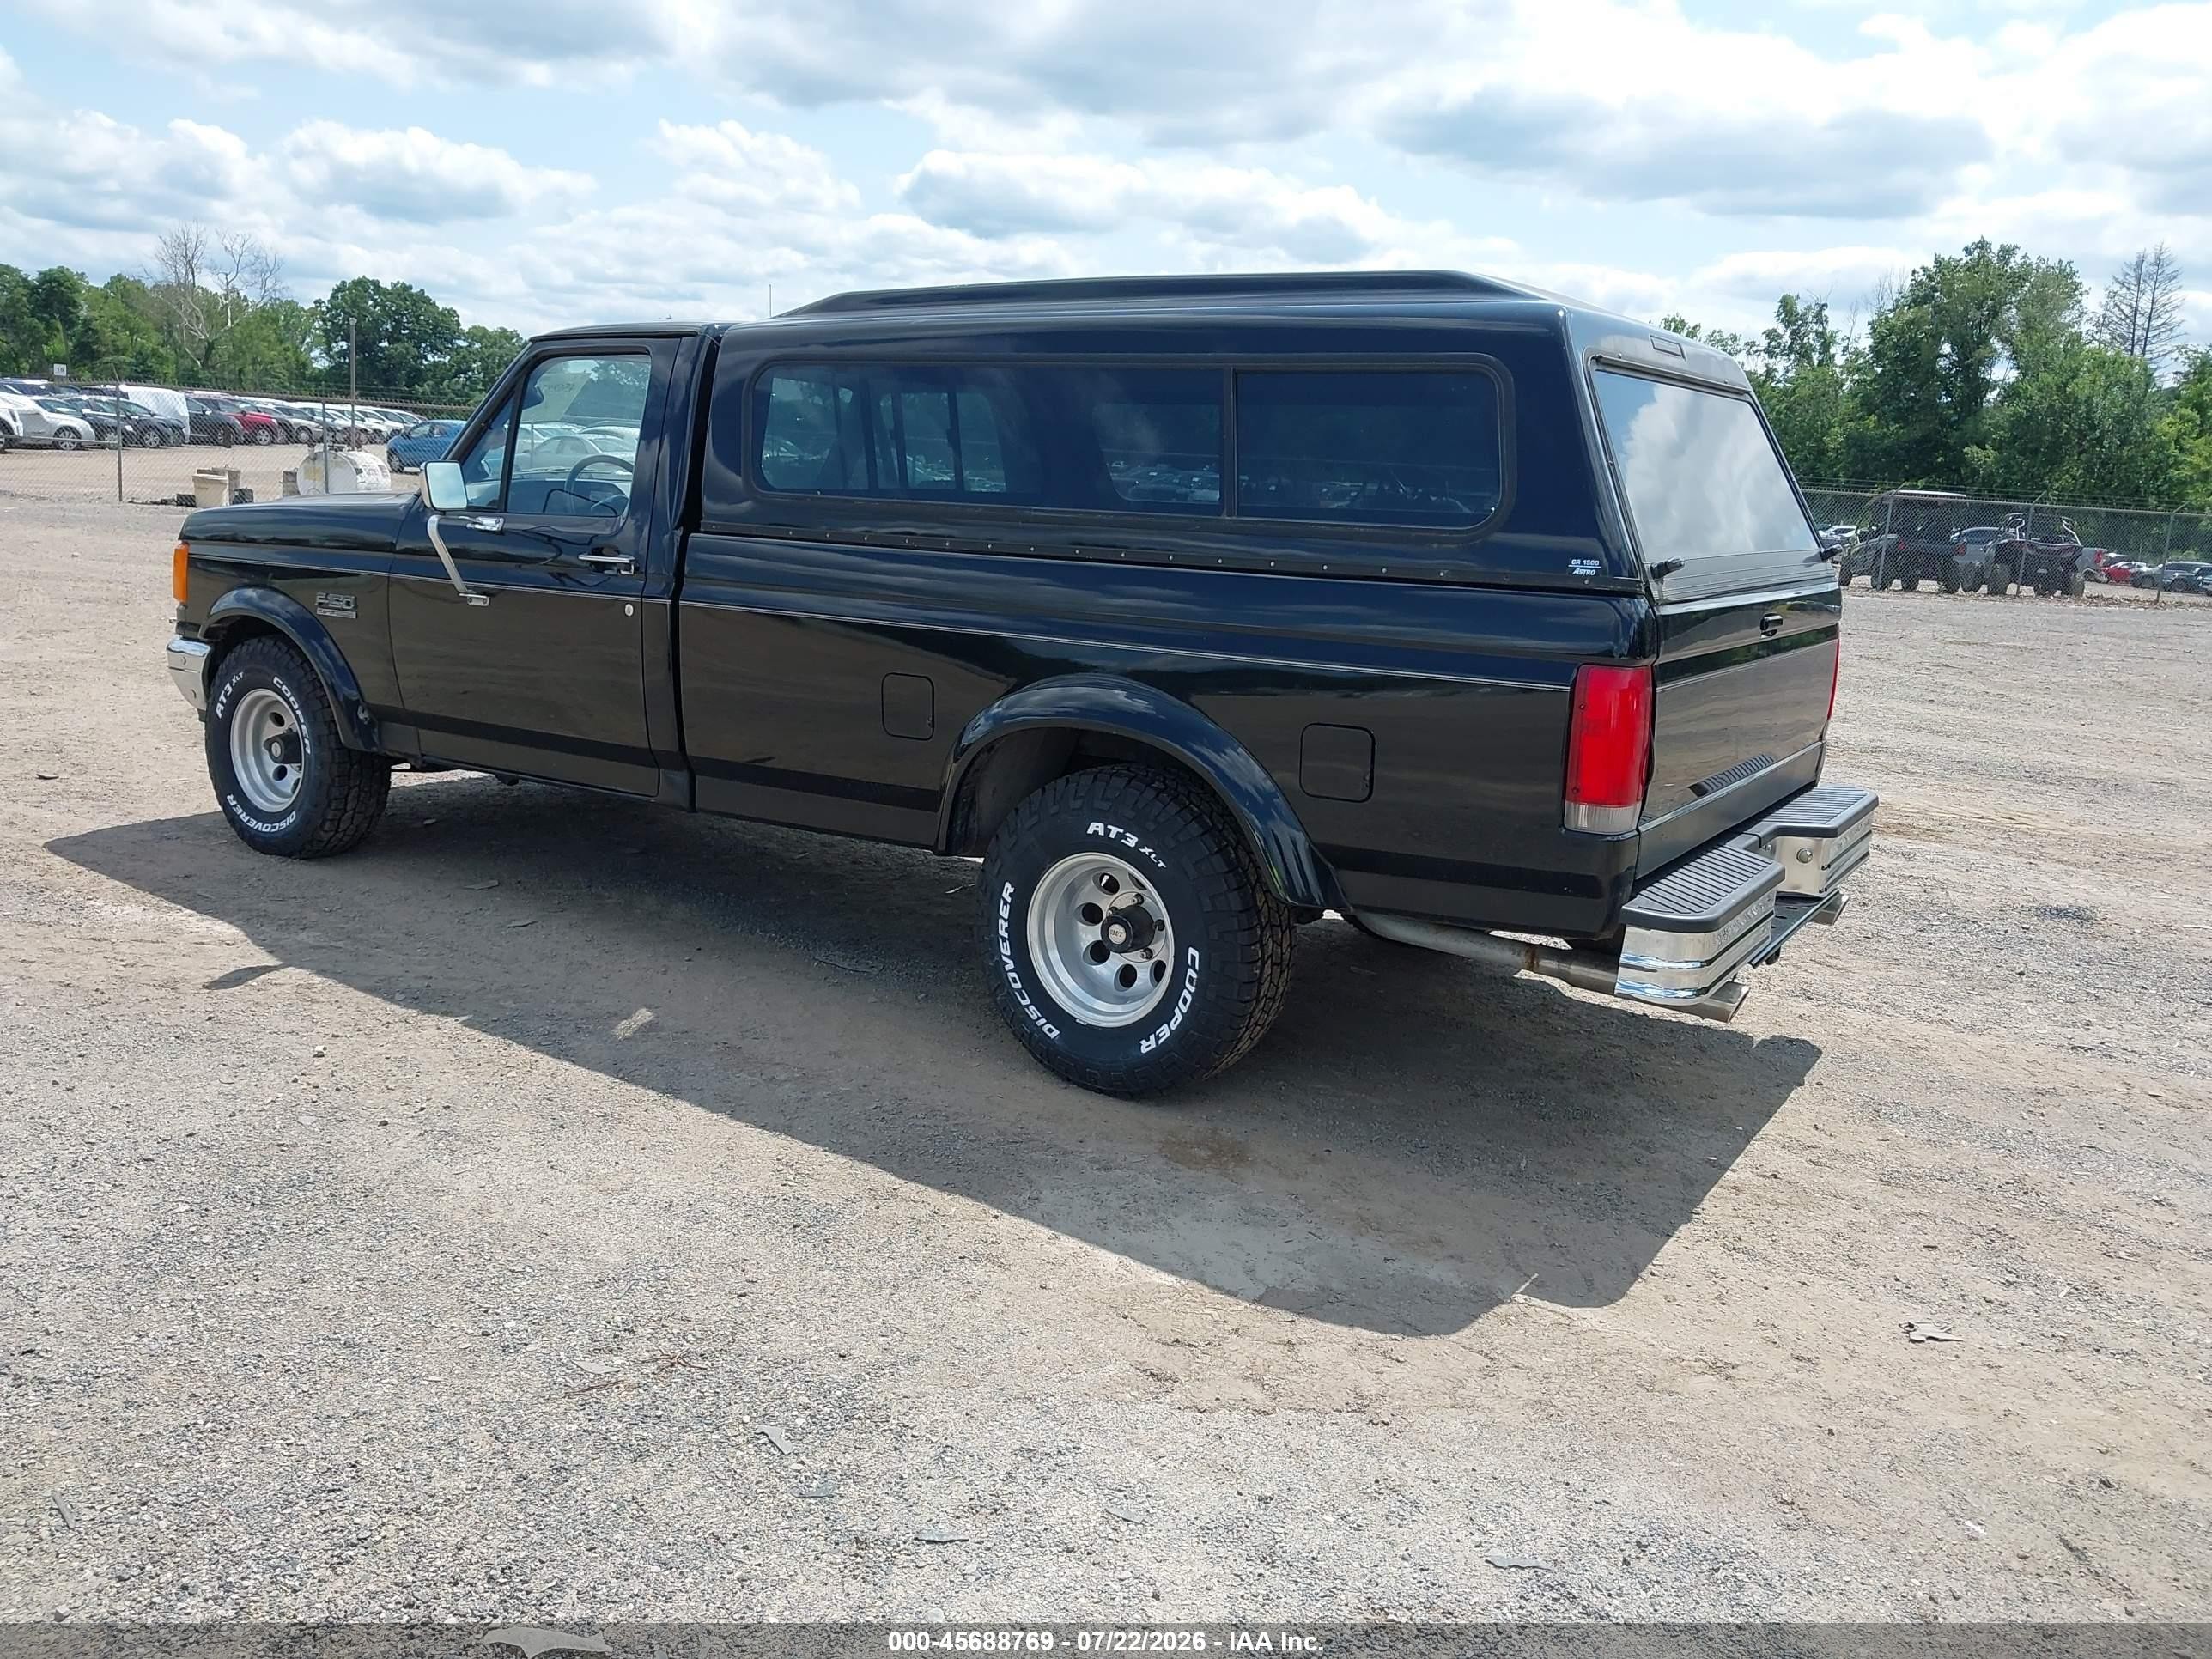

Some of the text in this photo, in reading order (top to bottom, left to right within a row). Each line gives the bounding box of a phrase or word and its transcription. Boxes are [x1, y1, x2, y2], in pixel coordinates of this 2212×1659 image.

[216, 672, 245, 719] AT3 XLT
[272, 676, 311, 756] COOPER
[226, 793, 296, 833] DISCOVERER
[1086, 822, 1167, 869] AT3 XLT
[998, 881, 1060, 1039] DISCOVERER
[1139, 946, 1200, 1054] COOPER
